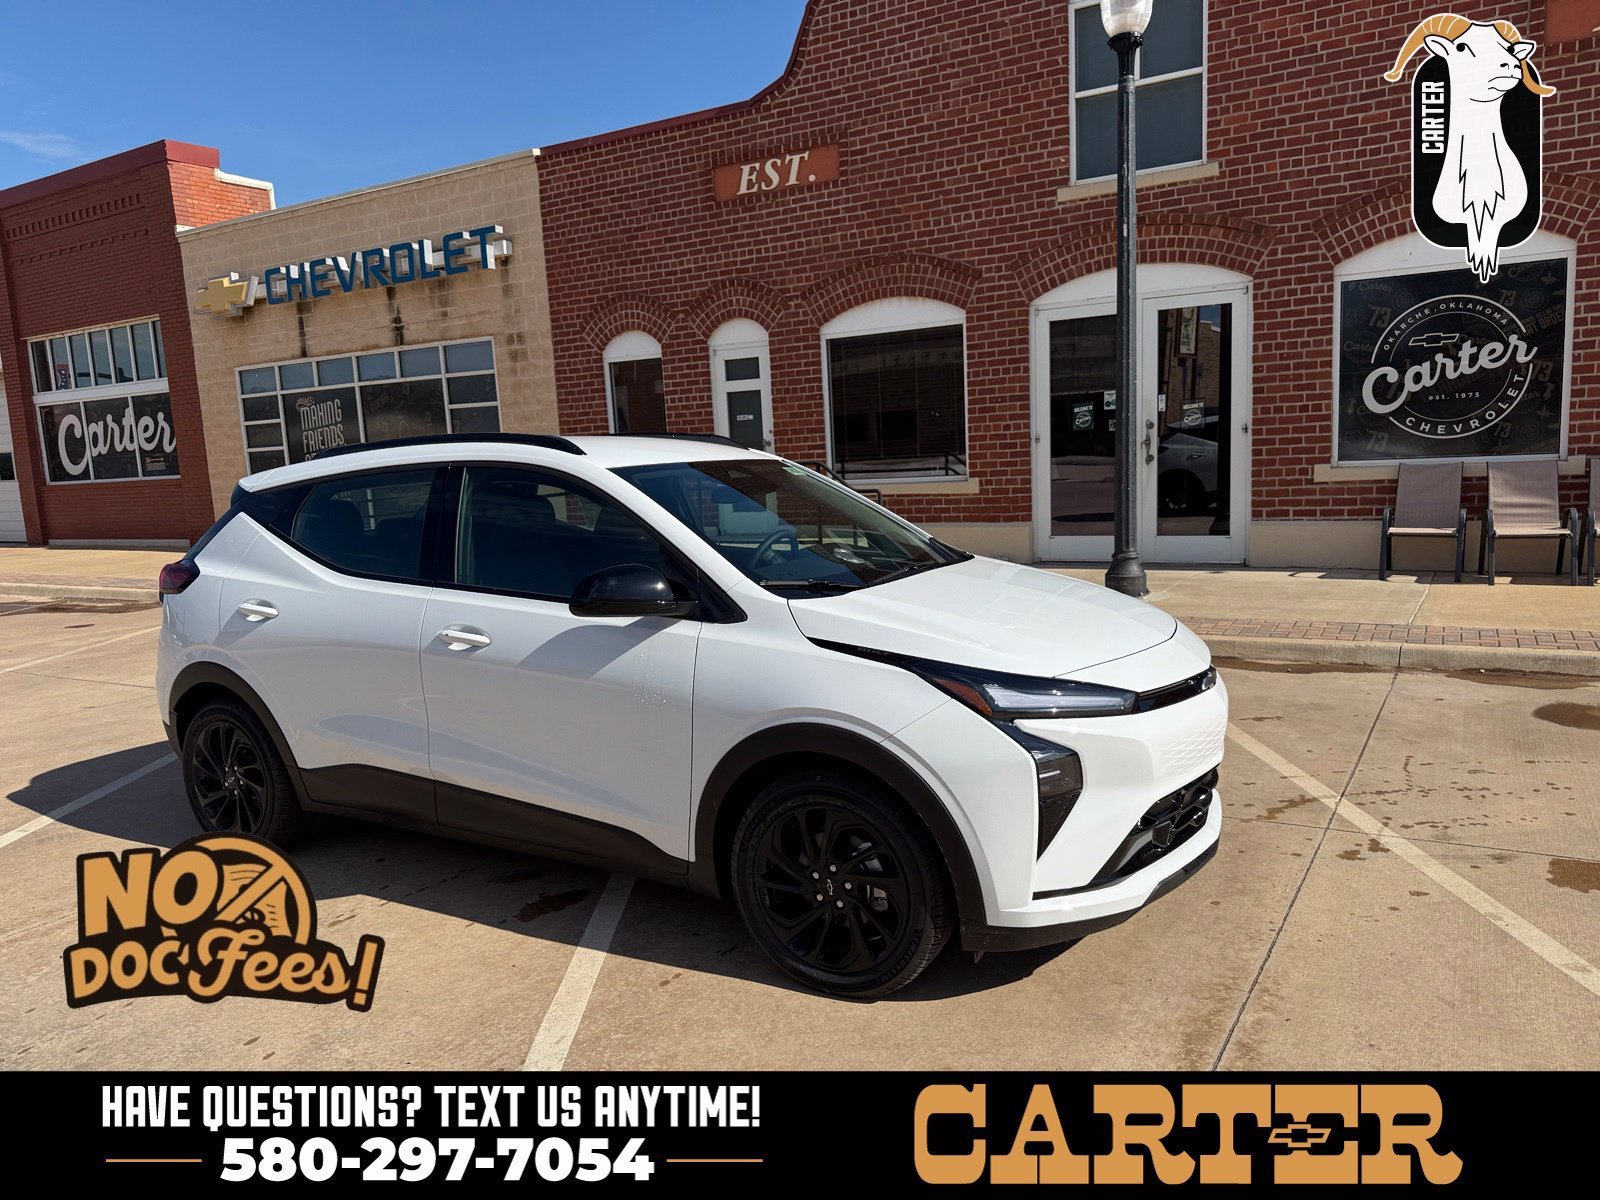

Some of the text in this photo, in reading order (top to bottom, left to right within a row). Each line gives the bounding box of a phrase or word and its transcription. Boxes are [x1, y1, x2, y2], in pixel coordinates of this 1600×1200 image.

[736, 150, 816, 195] EST.
[264, 225, 499, 305] CHEVROLET
[1439, 301, 1508, 326] OKLAHOMA
[1362, 334, 1538, 414] Carter
[1428, 391, 1480, 401] est. 1973
[300, 398, 342, 431] MAKING
[1405, 374, 1524, 434] CHEVROLET
[57, 407, 177, 476] Carter
